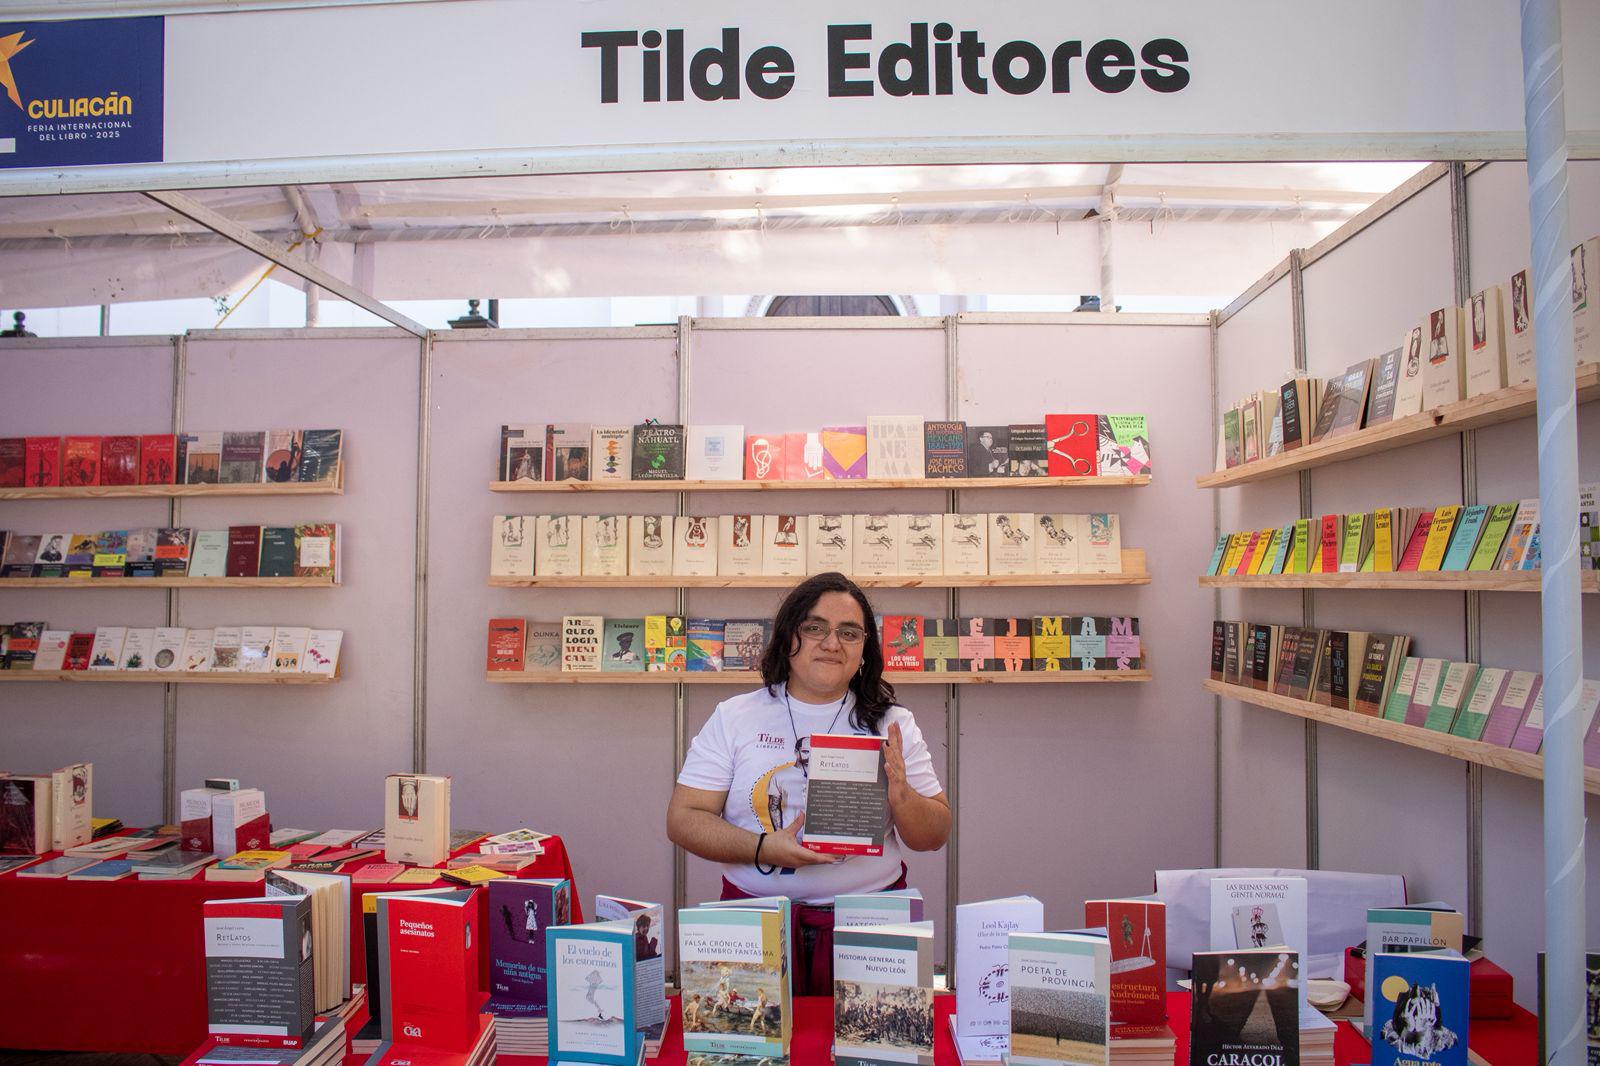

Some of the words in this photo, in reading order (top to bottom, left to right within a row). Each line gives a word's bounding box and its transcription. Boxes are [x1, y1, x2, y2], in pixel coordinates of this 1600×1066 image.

[582, 27, 794, 104] Tilde
[827, 22, 1190, 99] Editores
[28, 92, 132, 119] CULIACÁN
[27, 124, 54, 132] FERIA
[56, 121, 132, 131] INTERNACIONAL
[58, 133, 87, 141] LIBRO
[96, 131, 120, 139] 2025
[928, 465, 964, 473] PACHECO
[1264, 883, 1289, 892] SOMOS
[1254, 890, 1285, 899] NORMAL
[400, 919, 433, 931] Pequeños
[982, 920, 997, 929] Lool
[400, 929, 435, 938] asesinatos
[709, 939, 743, 948] CRÓNICA
[745, 941, 759, 949] DEL
[1382, 935, 1399, 943] BAR
[568, 944, 577, 955] El
[578, 946, 601, 956] vuelo
[602, 947, 613, 958] de
[697, 947, 733, 955] MIEMBRO
[735, 949, 775, 957] FANTASMA
[562, 955, 575, 965] los
[575, 957, 617, 968] estorninos
[838, 953, 868, 962] HISTORIA
[528, 964, 536, 972] de
[865, 964, 888, 973] NUEVO
[889, 965, 907, 974] LEÓN
[1021, 965, 1042, 975] POETA
[1045, 968, 1058, 977] DE
[1041, 976, 1096, 989] PROVINCIA
[1111, 990, 1161, 1000] Andrómeda
[1207, 1053, 1283, 1066] CARACOL
